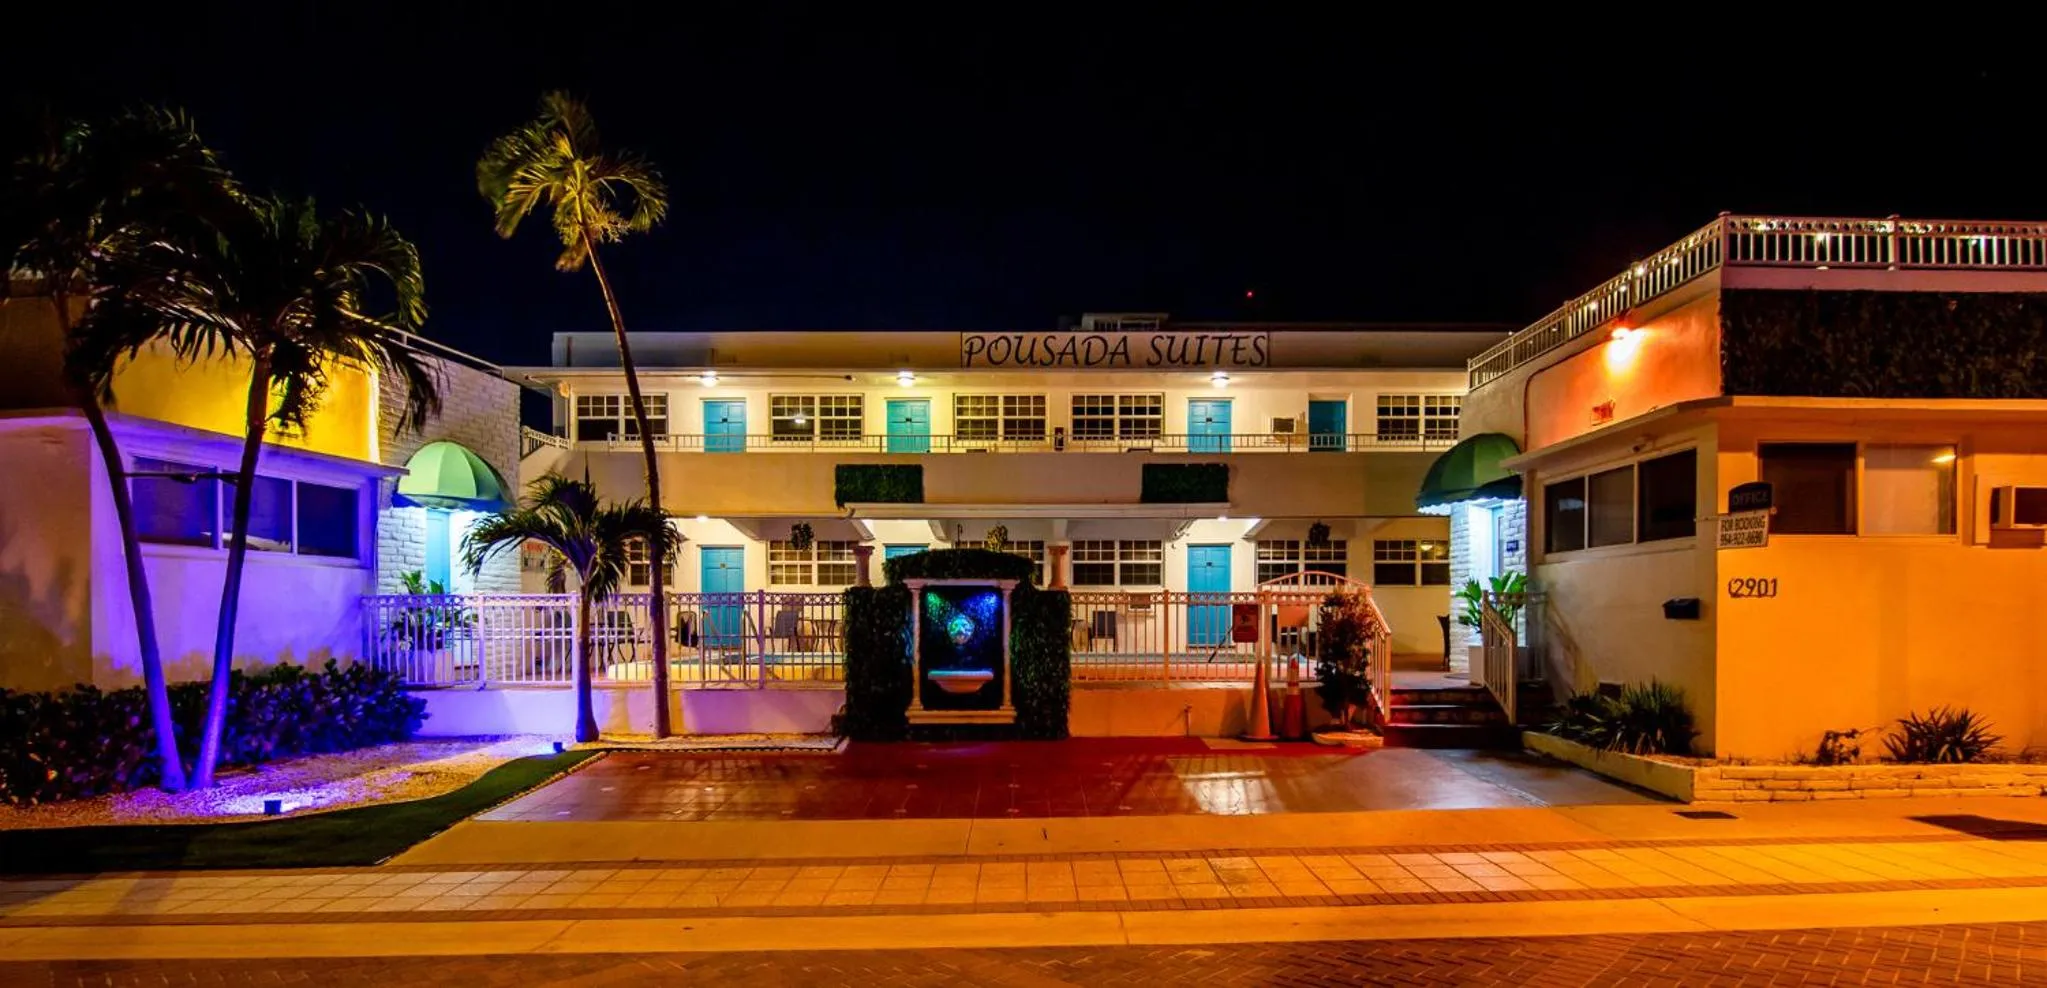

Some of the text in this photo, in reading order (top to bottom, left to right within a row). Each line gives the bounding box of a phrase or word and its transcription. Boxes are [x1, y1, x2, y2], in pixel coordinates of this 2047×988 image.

[964, 335, 1267, 368] POUSADA SUITES
[1732, 491, 1769, 505] OFFICE
[1720, 515, 1766, 531] FOR BOOKING
[1729, 578, 1777, 598] 2901
